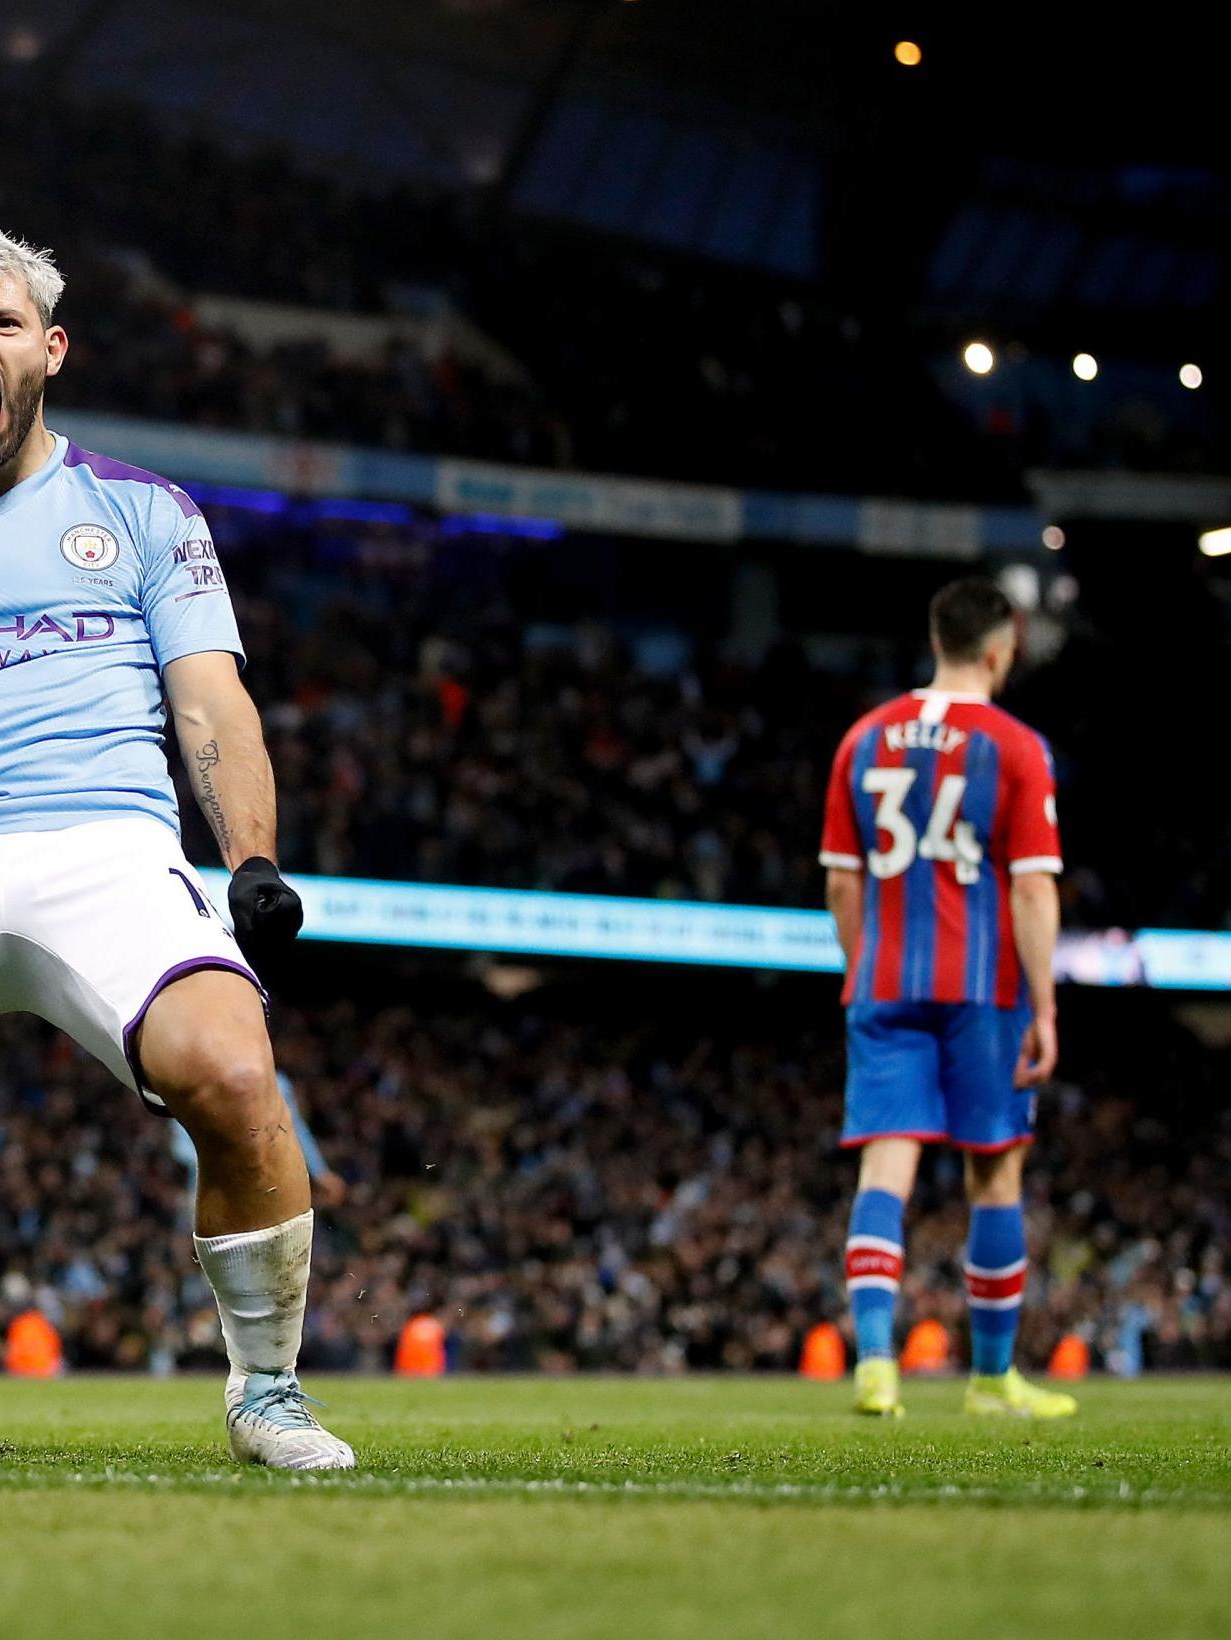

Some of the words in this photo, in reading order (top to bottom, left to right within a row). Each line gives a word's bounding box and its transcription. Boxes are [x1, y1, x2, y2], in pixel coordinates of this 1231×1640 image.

[66, 528, 112, 541] MANCHESTER
[89, 578, 114, 586] YEARS
[884, 719, 967, 753] KELLY
[862, 768, 982, 885] 34
